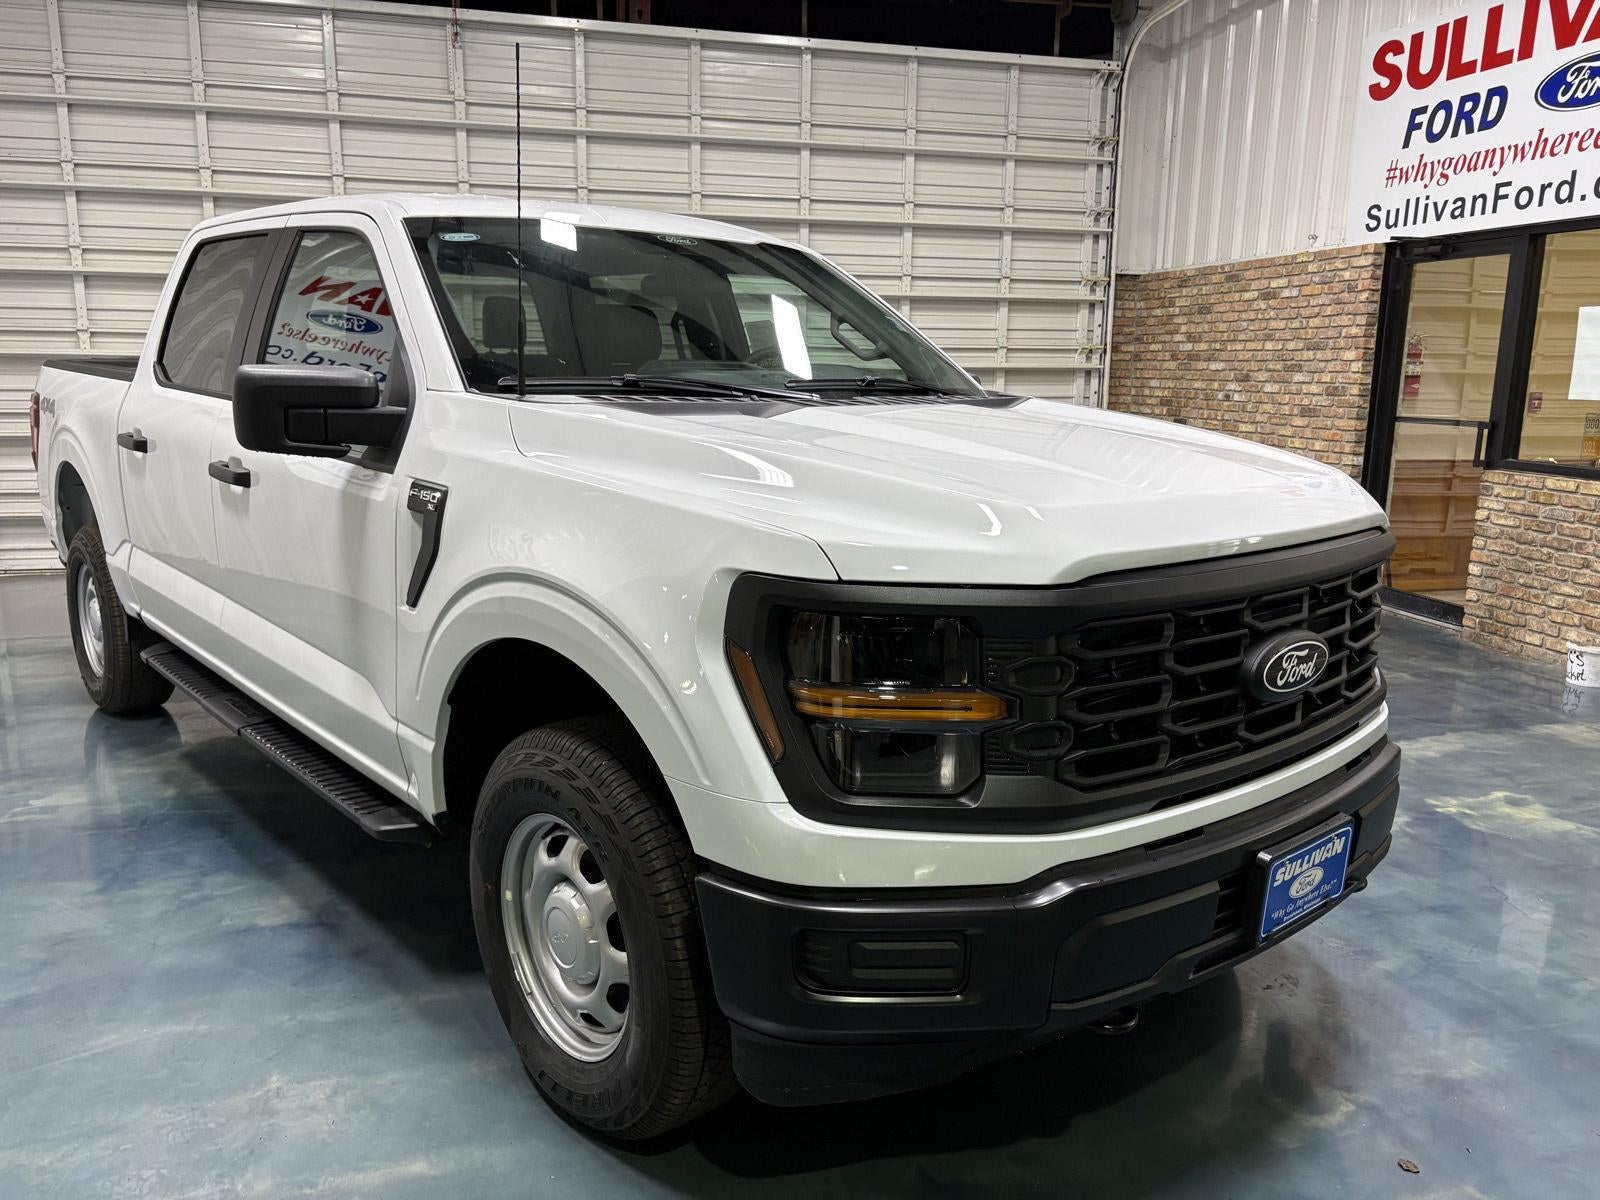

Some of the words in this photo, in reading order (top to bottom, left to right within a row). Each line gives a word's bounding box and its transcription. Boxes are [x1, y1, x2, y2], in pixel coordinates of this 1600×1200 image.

[1402, 85, 1508, 149] FORD
[409, 488, 441, 503] F-150
[1276, 648, 1318, 687] Ford
[1273, 835, 1346, 887] SULLIVAN
[1295, 873, 1318, 895] Ford
